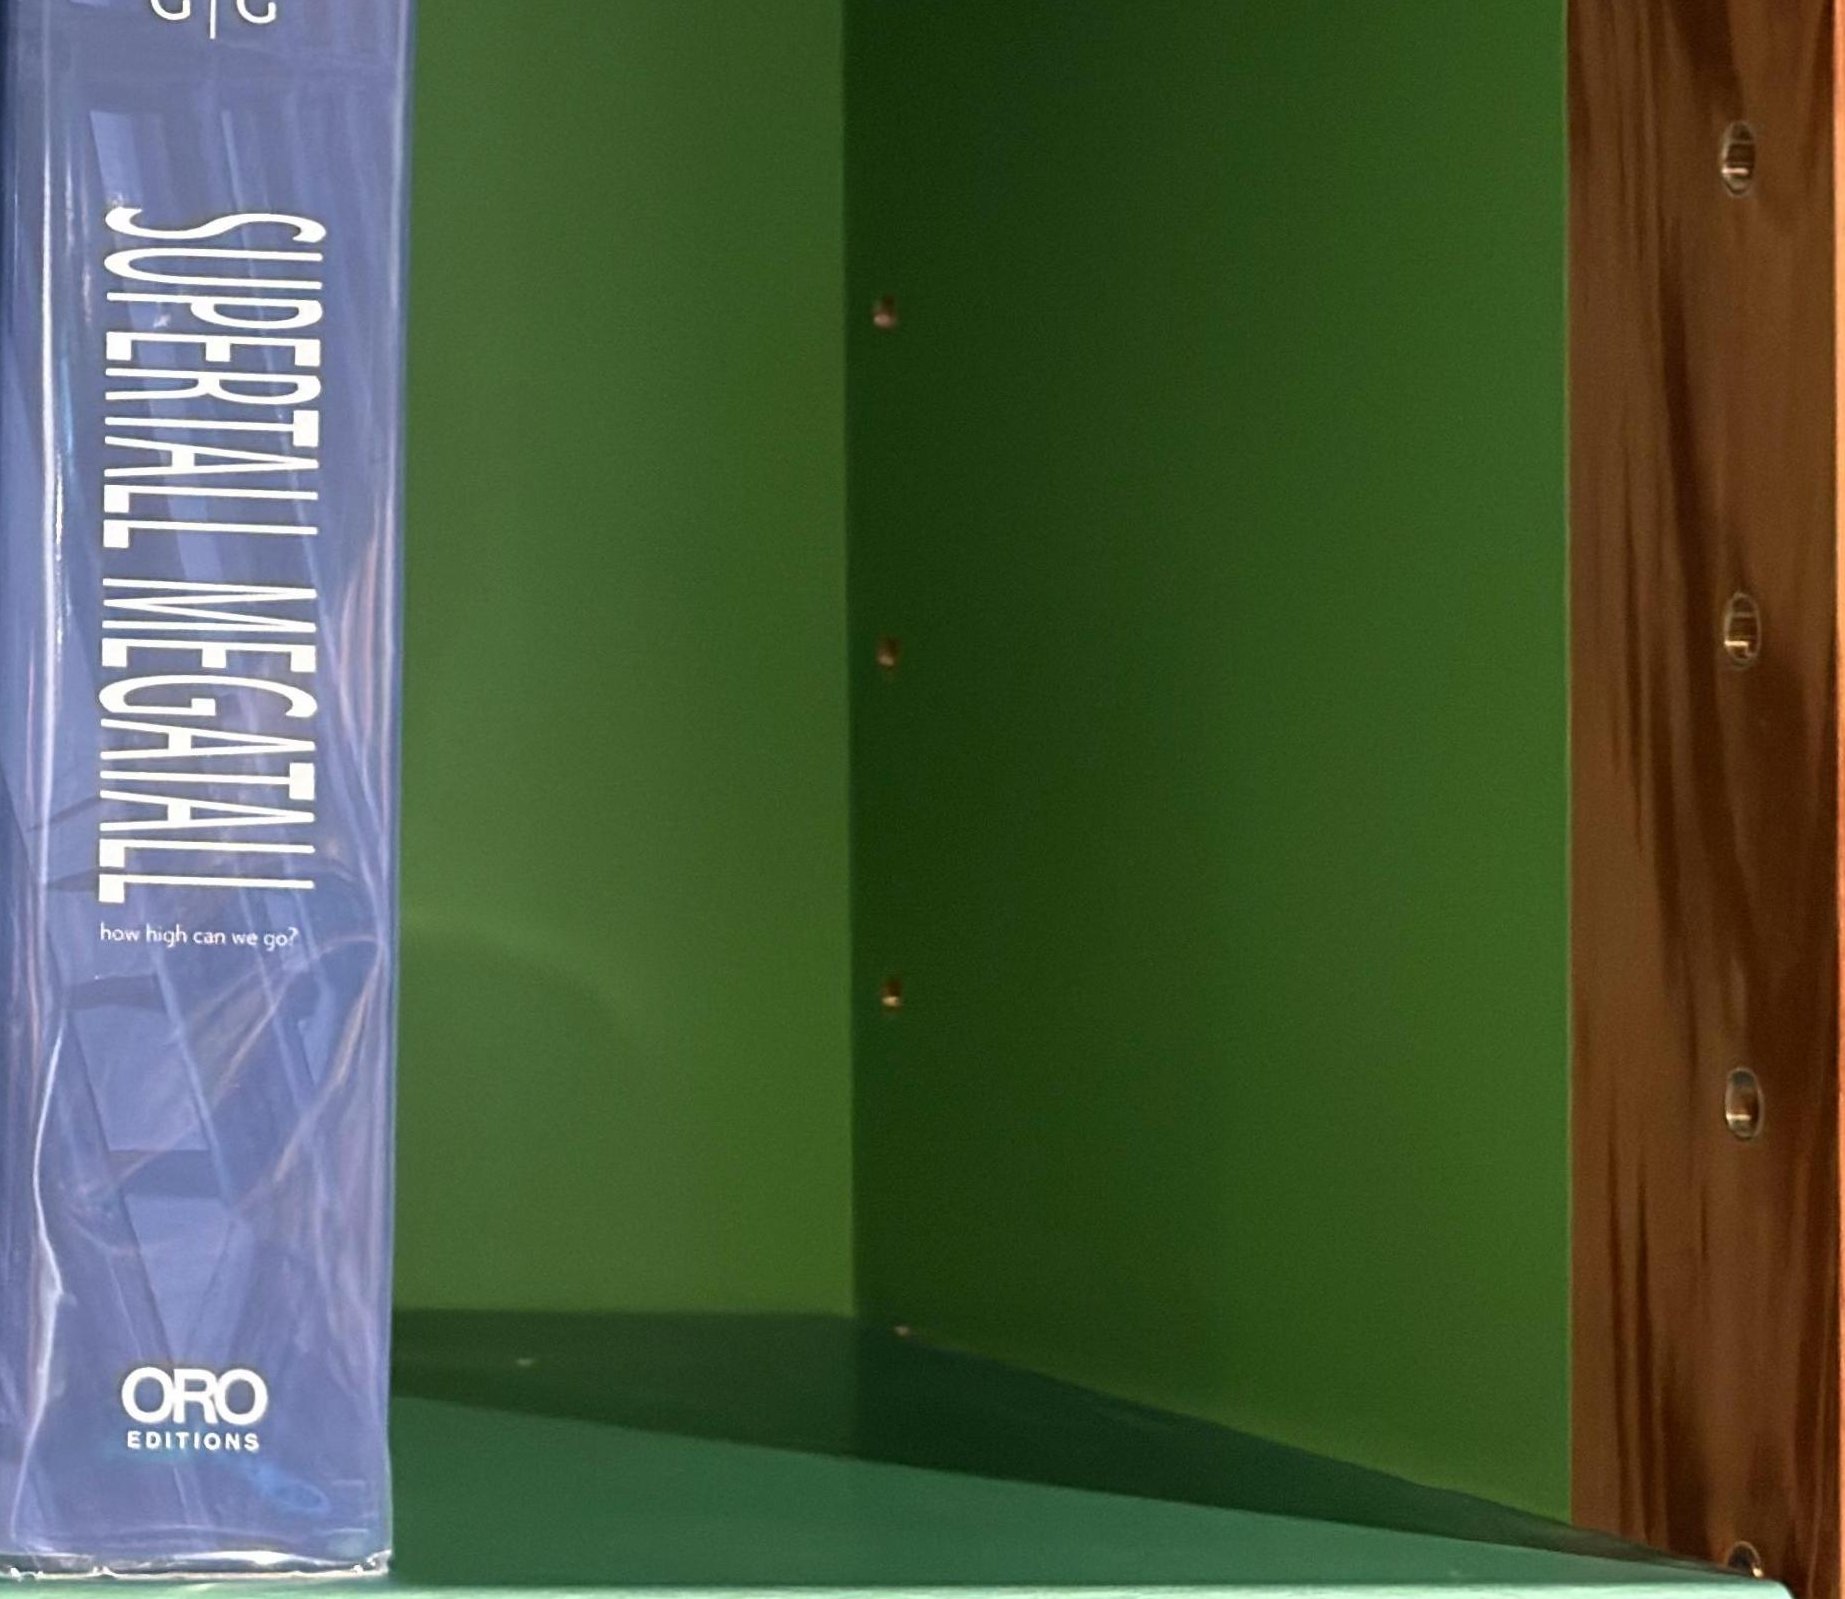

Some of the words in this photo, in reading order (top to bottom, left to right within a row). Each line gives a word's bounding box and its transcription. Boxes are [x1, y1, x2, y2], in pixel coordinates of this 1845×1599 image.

[102, 205, 327, 549] SUPERTALL
[97, 576, 318, 903] MEGATALL
[100, 922, 140, 942] how
[145, 922, 187, 949] high
[192, 930, 226, 946] can
[232, 933, 258, 947] we
[263, 927, 300, 952] go?
[120, 1366, 269, 1427] ORO
[126, 1430, 261, 1453] EDITIONS
